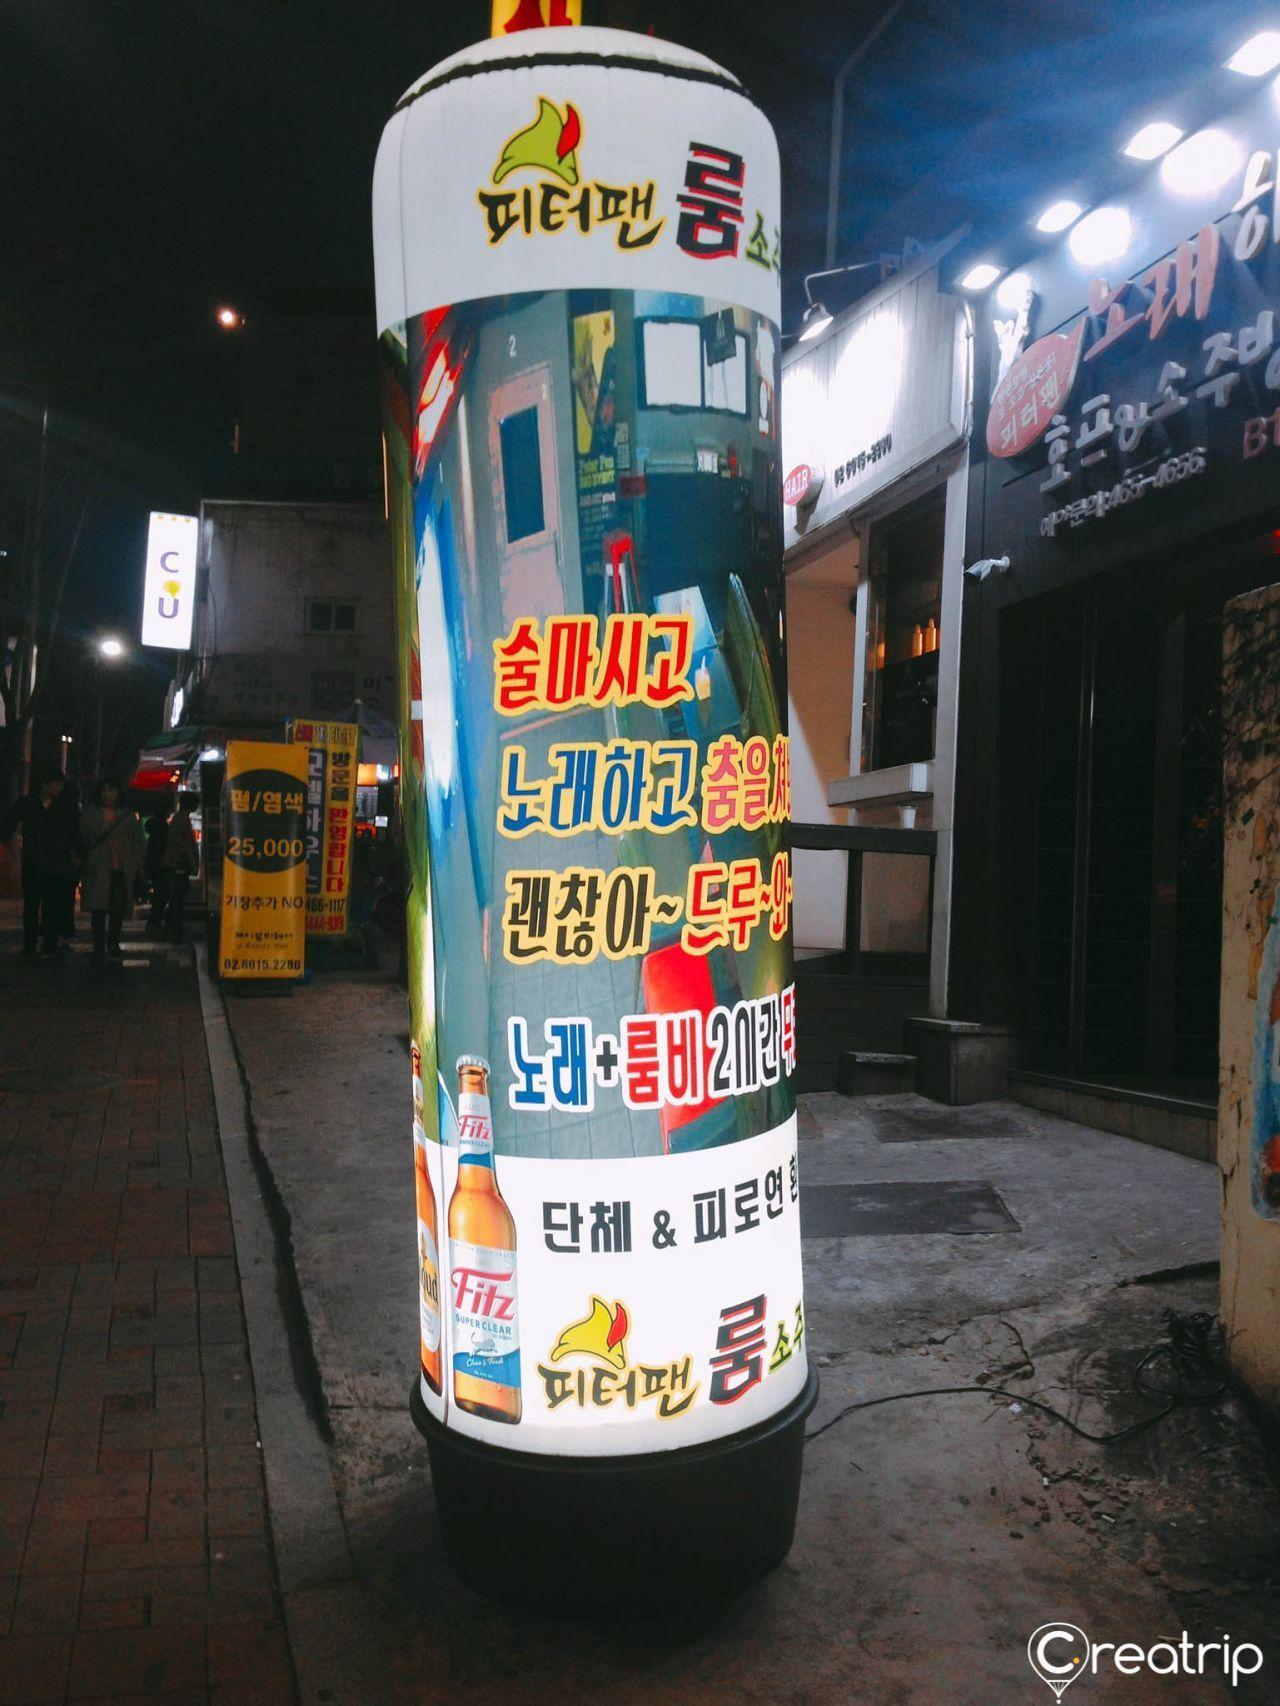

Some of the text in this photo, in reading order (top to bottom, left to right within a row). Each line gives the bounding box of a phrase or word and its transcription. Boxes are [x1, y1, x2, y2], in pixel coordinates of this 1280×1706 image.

[477, 182, 664, 249] 피터팬
[783, 470, 808, 501] HAIR
[158, 551, 180, 619] CU
[499, 620, 689, 709] 술마시고
[230, 789, 304, 814] 펌/염색
[502, 745, 692, 833] 노래하고
[228, 836, 304, 859] 25,000
[459, 1114, 491, 1140] Fitz
[542, 1200, 632, 1253] 단체
[651, 1210, 678, 1249] &
[692, 1165, 784, 1244] 피로연
[450, 1266, 516, 1321] Fitz
[539, 1359, 698, 1420] 피터팬
